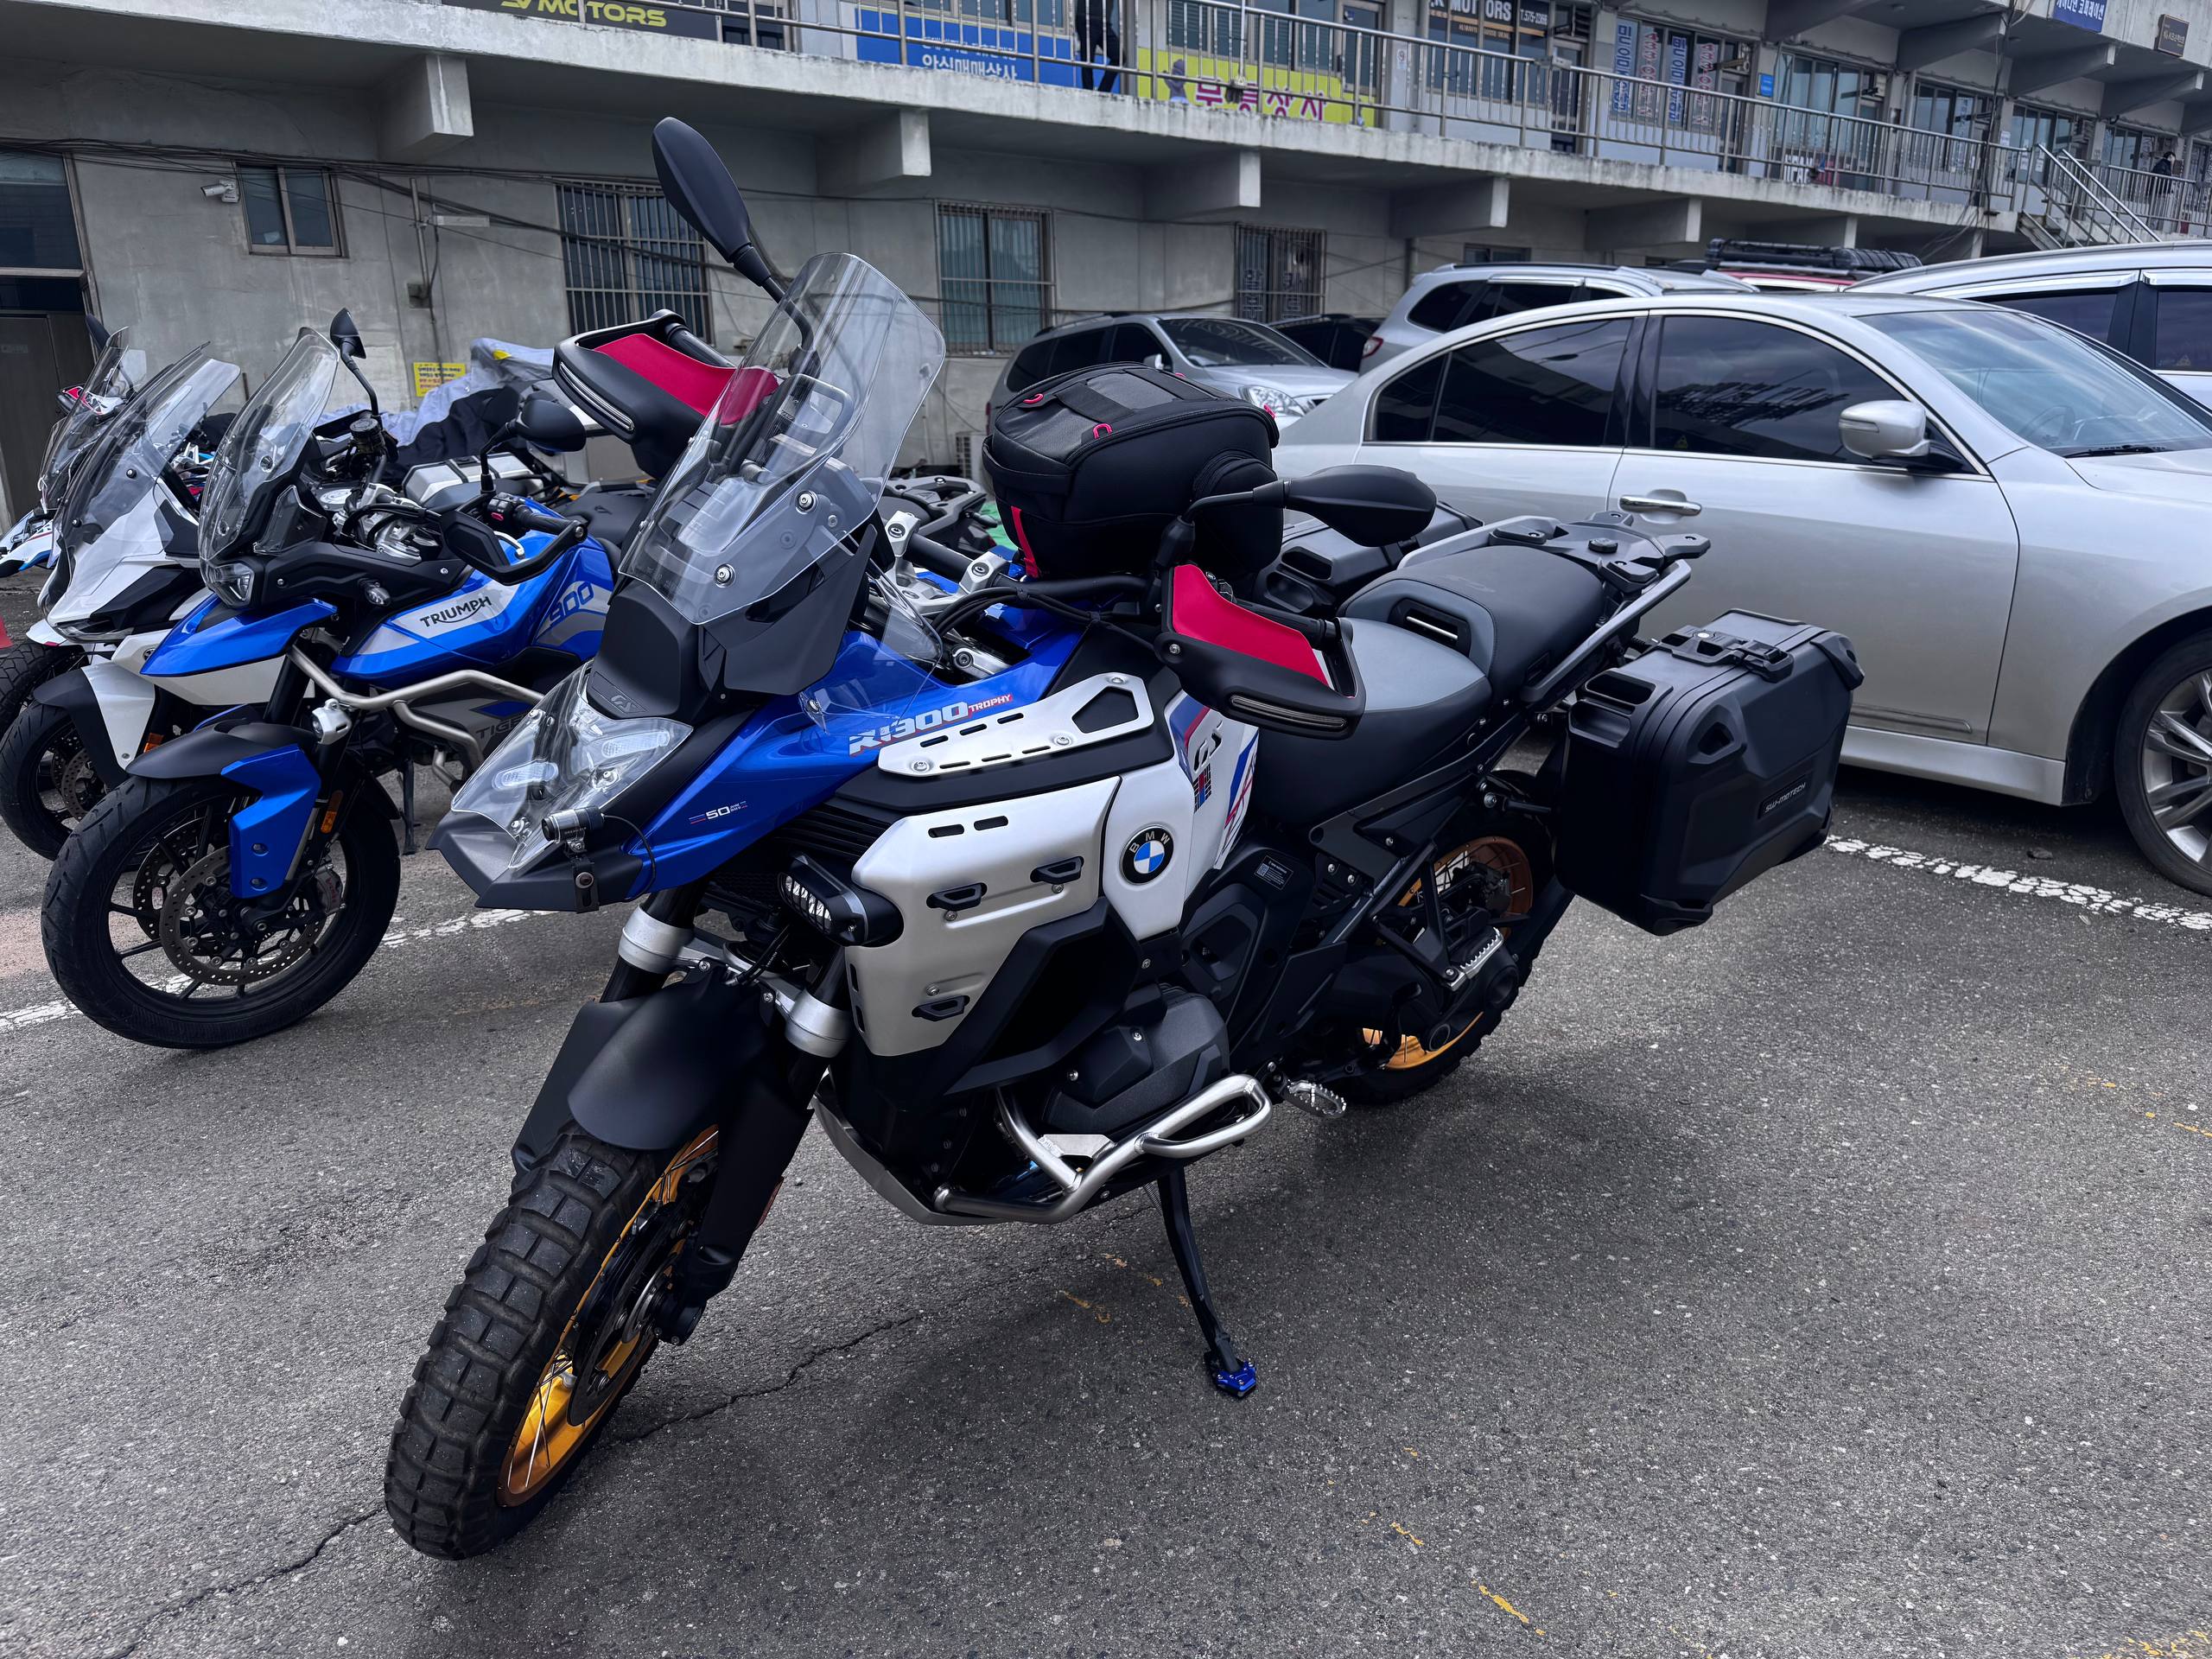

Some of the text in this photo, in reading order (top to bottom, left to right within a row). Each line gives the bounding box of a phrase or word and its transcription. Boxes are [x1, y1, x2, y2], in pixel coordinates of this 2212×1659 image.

[537, 0, 667, 28] MOTORS
[420, 596, 493, 627] TRIUMPH
[550, 582, 594, 624] 900
[969, 695, 1013, 714] TROPHY
[706, 806, 731, 820] 50
[1128, 830, 1171, 854] BMW
